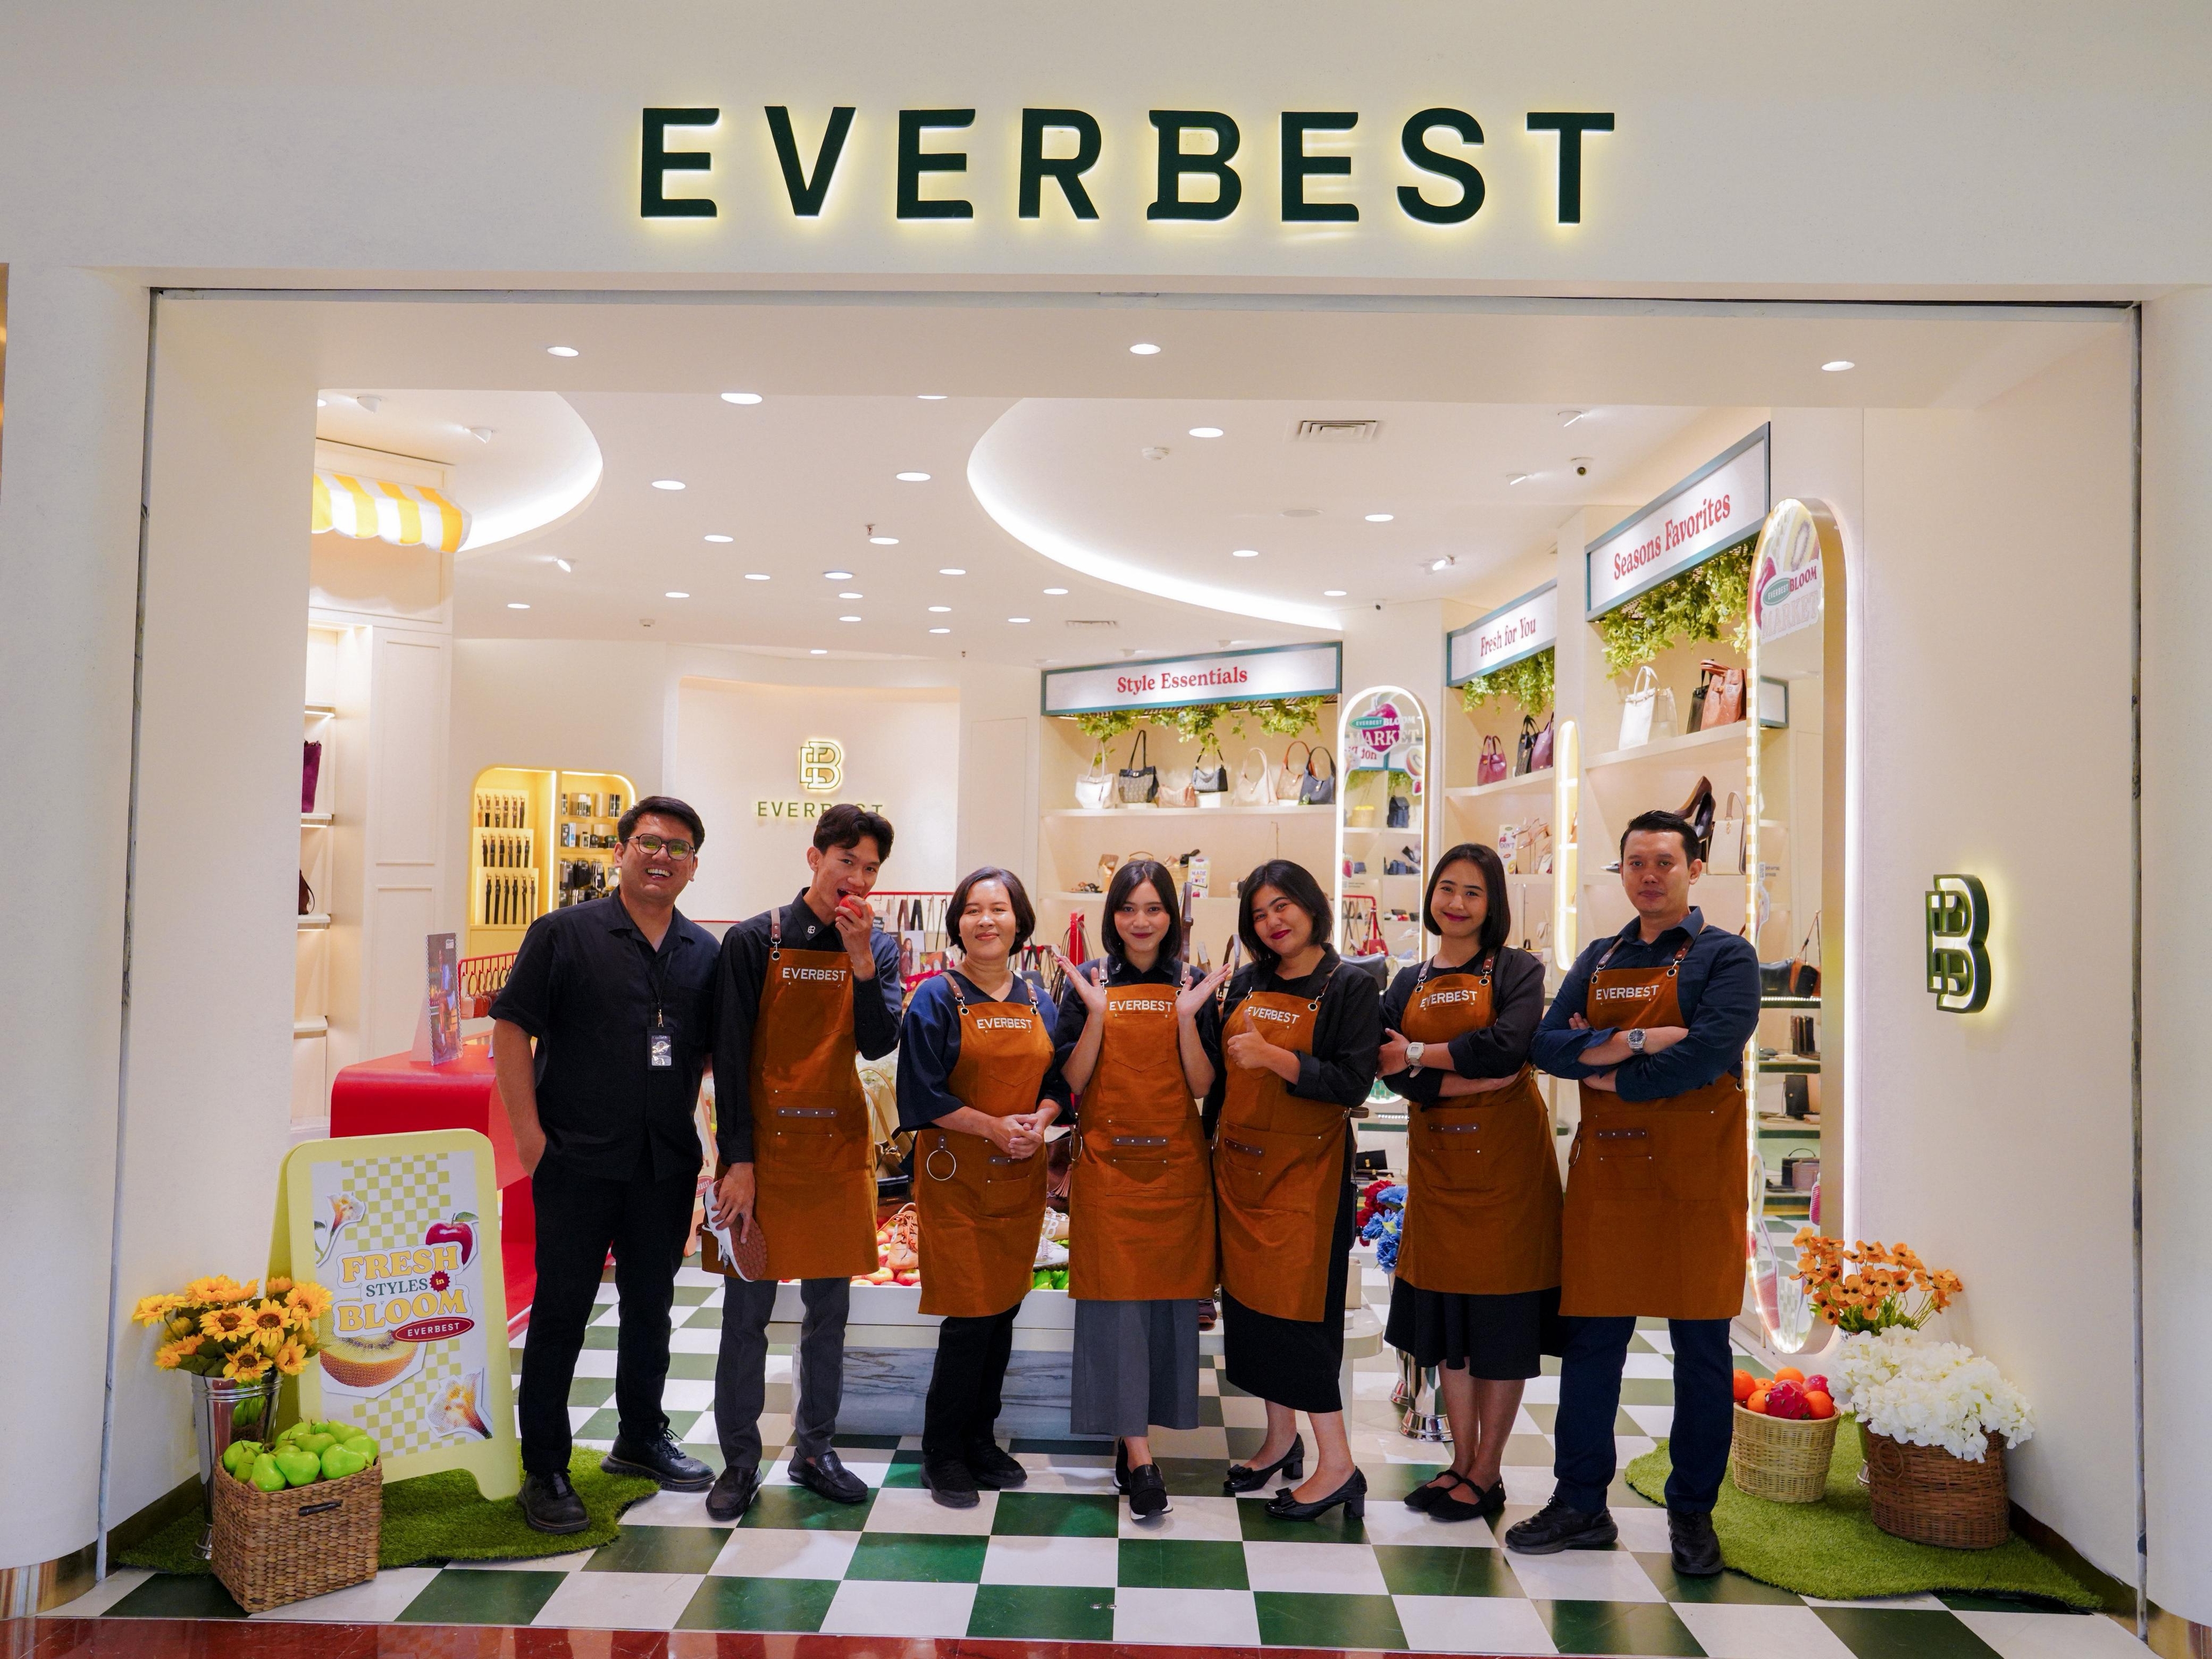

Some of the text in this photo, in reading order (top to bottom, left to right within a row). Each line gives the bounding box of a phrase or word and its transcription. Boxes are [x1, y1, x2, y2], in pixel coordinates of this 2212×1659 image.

[641, 105, 1615, 225] EVERBEST
[1614, 494, 1730, 580] Seasons Favorites
[1767, 566, 1817, 600] EVERBEST BLOOM
[1762, 590, 1819, 639] MARKET
[1480, 617, 1536, 657] Fresh for You
[1117, 666, 1248, 695] Style Essentials
[1348, 729, 1419, 747] MARKET
[757, 801, 883, 817] EVERT
[782, 967, 847, 982] EVERBEST
[1419, 990, 1478, 1008] EVERBEST
[1596, 984, 1660, 1000] EVERBEST
[1109, 999, 1173, 1012] EVERBEST
[976, 1017, 1032, 1029] EVERBEST
[1248, 1006, 1301, 1024] EVERBEST
[342, 1245, 459, 1283] FRESH
[366, 1278, 429, 1297] STYLES
[338, 1289, 468, 1331] BLOOM
[407, 1322, 460, 1337] EVERBEST
